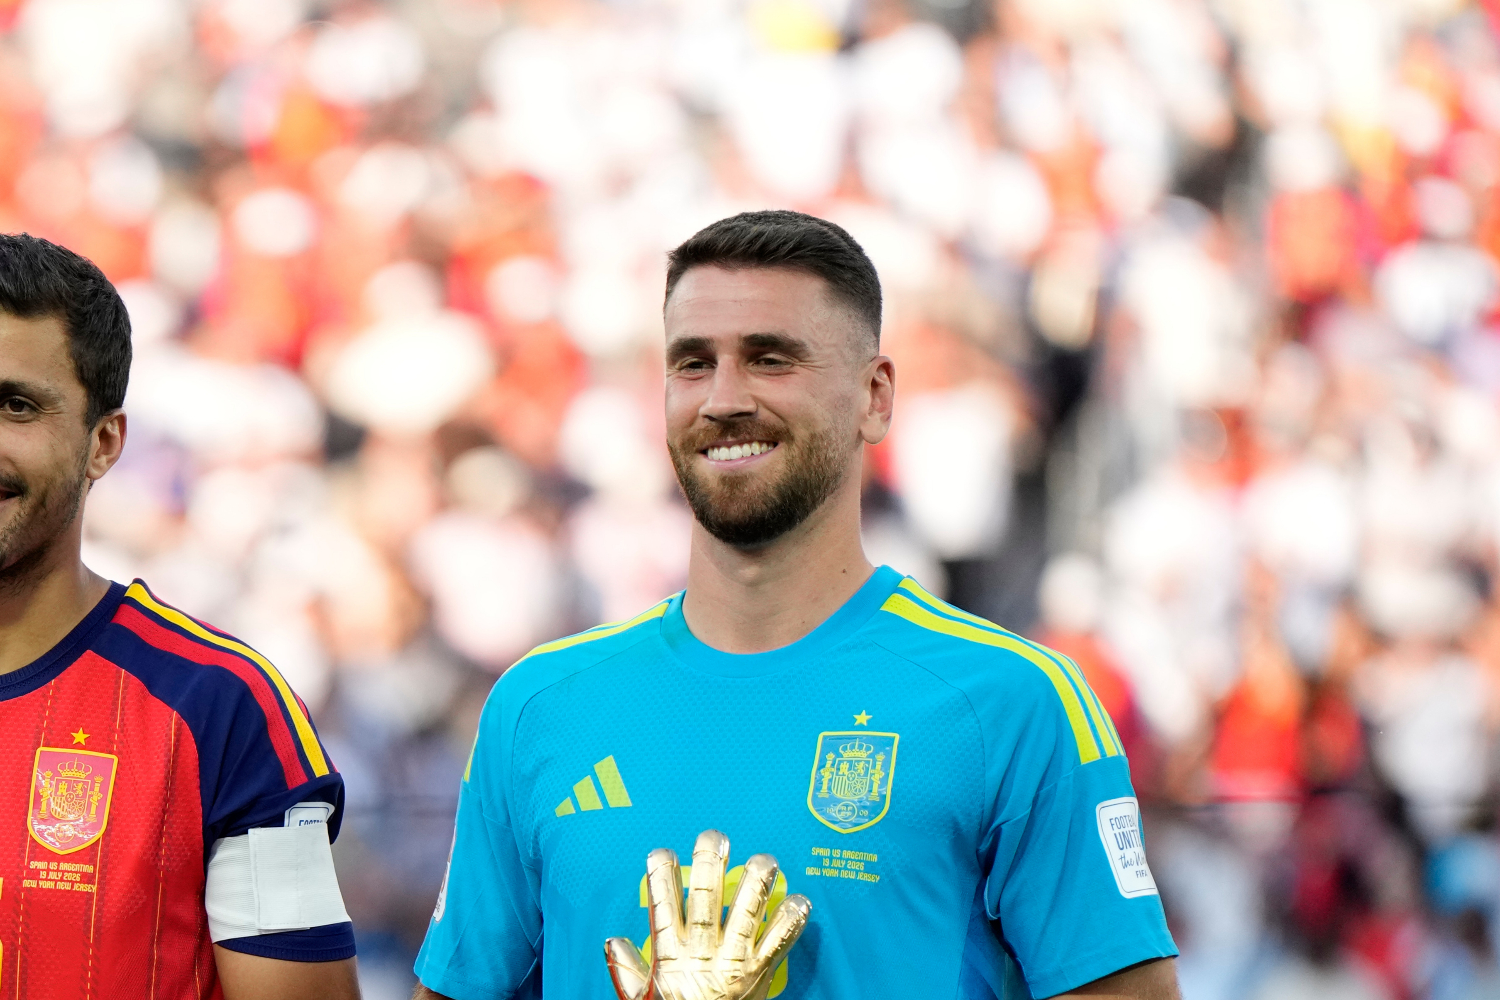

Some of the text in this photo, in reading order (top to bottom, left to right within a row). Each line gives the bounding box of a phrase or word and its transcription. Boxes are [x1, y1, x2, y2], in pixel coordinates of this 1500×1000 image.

[1109, 815, 1137, 831] FOOTB
[1114, 829, 1141, 850] UNIT
[811, 847, 830, 856] SPAIN
[842, 850, 877, 862] ARGENTINA
[29, 861, 48, 869] SPAIN
[59, 862, 94, 873] ARGENTINA
[823, 858, 864, 871] 19 JULY 2026
[48, 871, 62, 879] JULY
[63, 872, 81, 881] 2026
[806, 867, 880, 883] NEW YORK NEW JERSEY
[23, 879, 96, 893] NEW YORK NEW JERSEY
